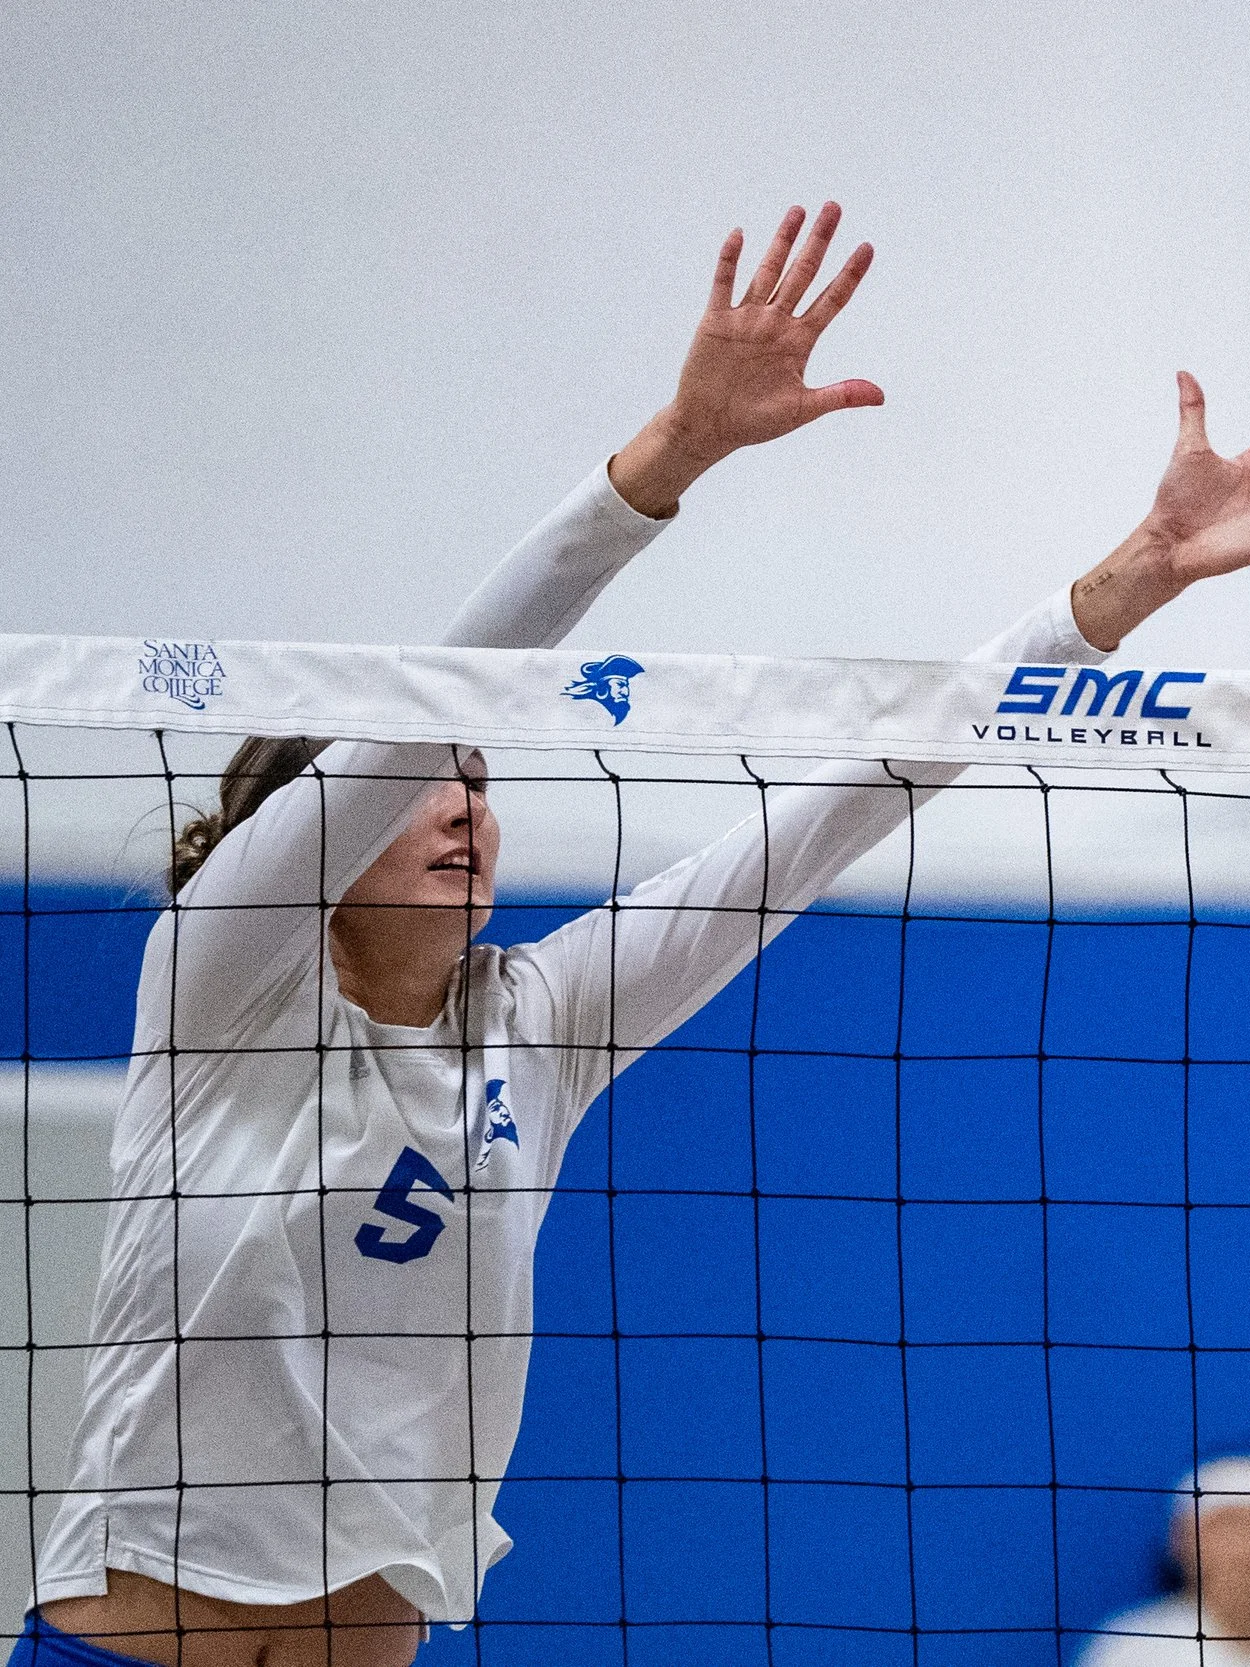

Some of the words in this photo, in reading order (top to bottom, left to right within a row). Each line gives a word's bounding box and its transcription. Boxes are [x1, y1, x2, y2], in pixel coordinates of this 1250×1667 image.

[144, 639, 218, 660] SANTA
[138, 658, 226, 677] MONICA
[142, 676, 223, 710] COLLEGE
[996, 666, 1207, 719] SMC
[972, 724, 1212, 747] VOLLEYBALL
[354, 1146, 455, 1264] 5
